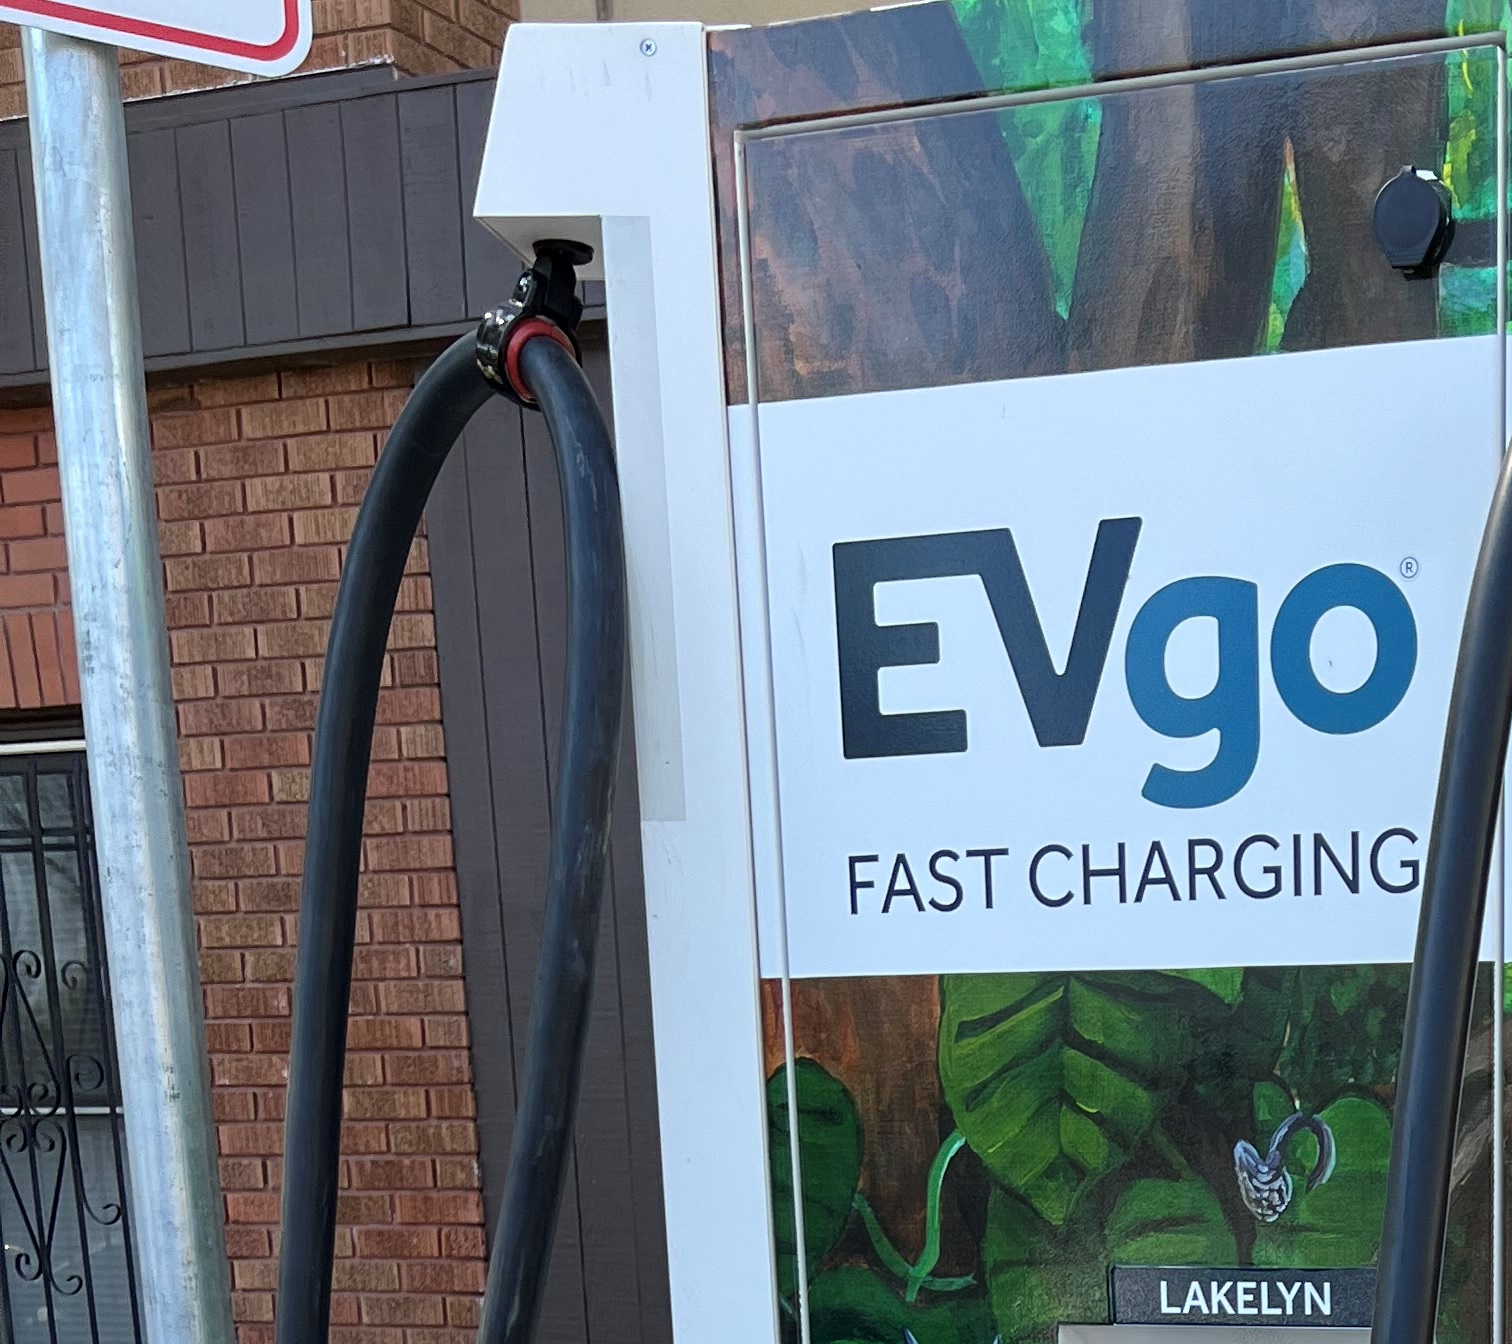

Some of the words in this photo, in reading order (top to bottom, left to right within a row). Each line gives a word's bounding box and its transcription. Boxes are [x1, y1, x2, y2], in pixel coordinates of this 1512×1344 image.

[847, 848, 1010, 916] FAST
[1029, 827, 1421, 907] CHARGING
[1160, 1280, 1332, 1316] LAKELYN
